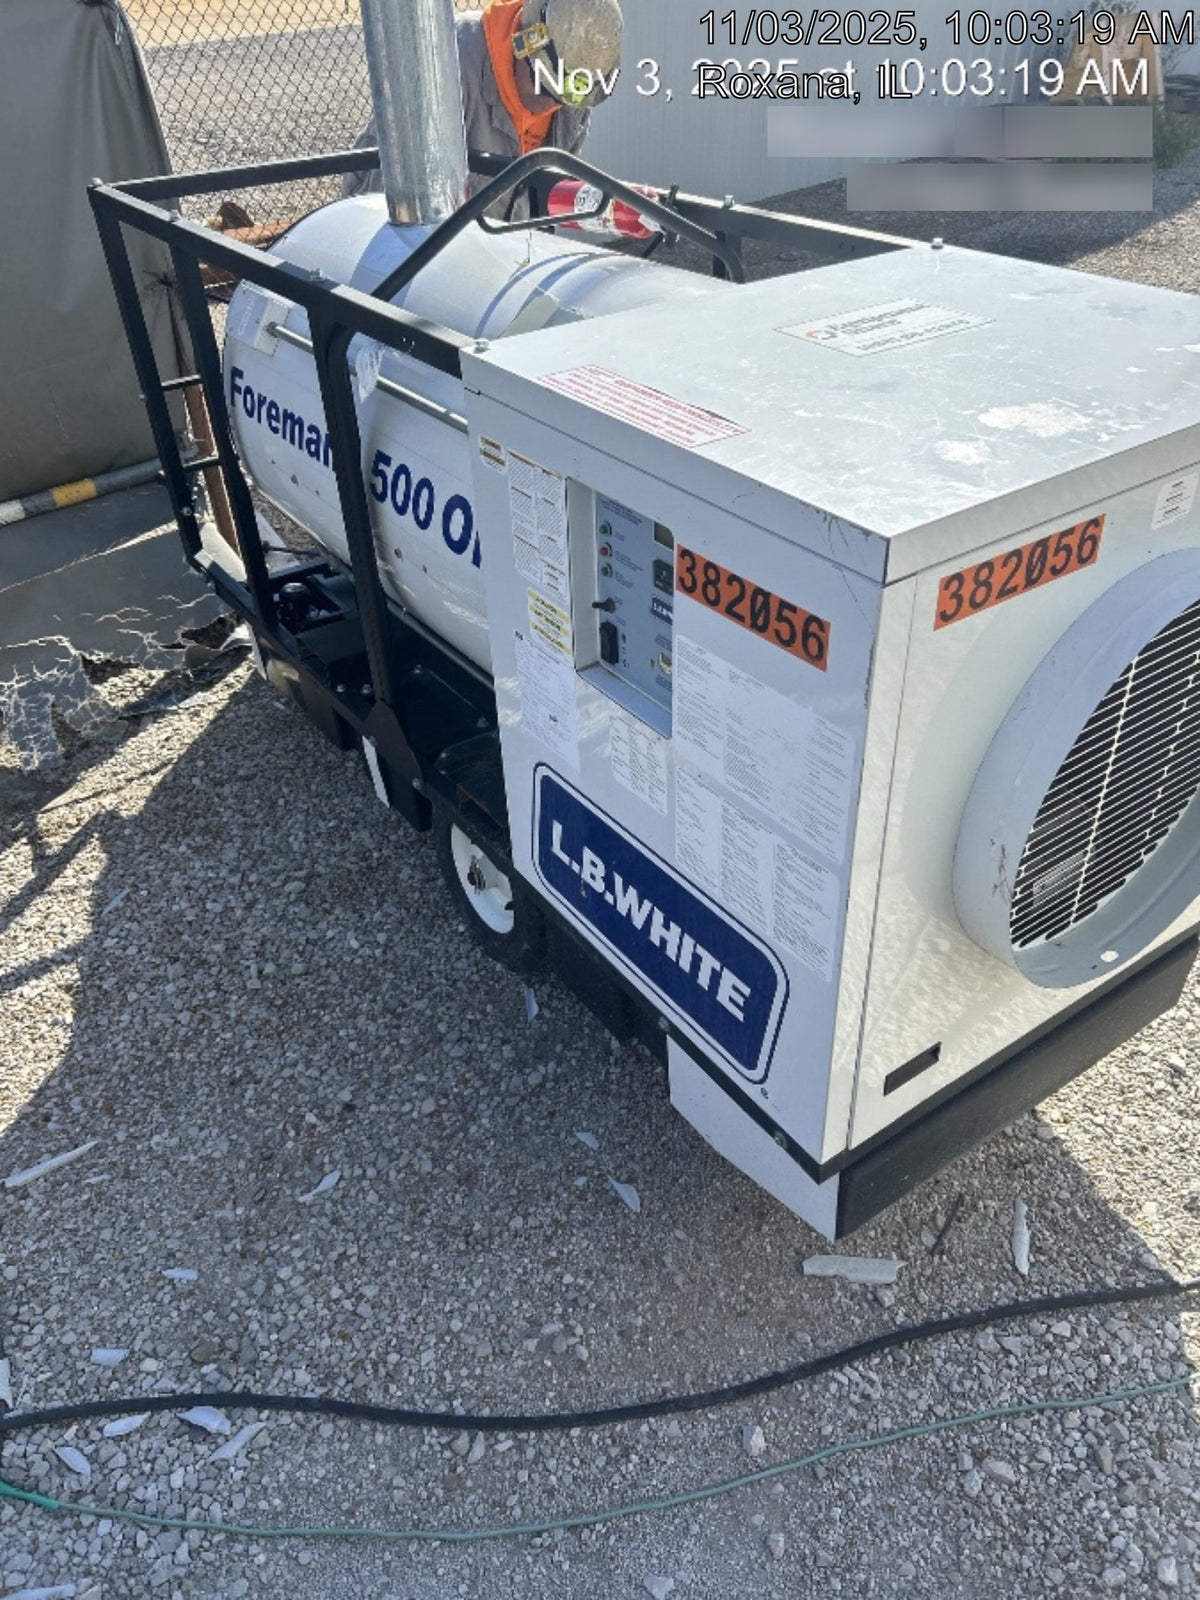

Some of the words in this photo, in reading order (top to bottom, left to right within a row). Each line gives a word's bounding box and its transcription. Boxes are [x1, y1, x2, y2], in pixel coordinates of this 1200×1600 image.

[369, 449, 435, 530] 500
[679, 549, 826, 662] 382056
[940, 517, 1101, 622] 382056
